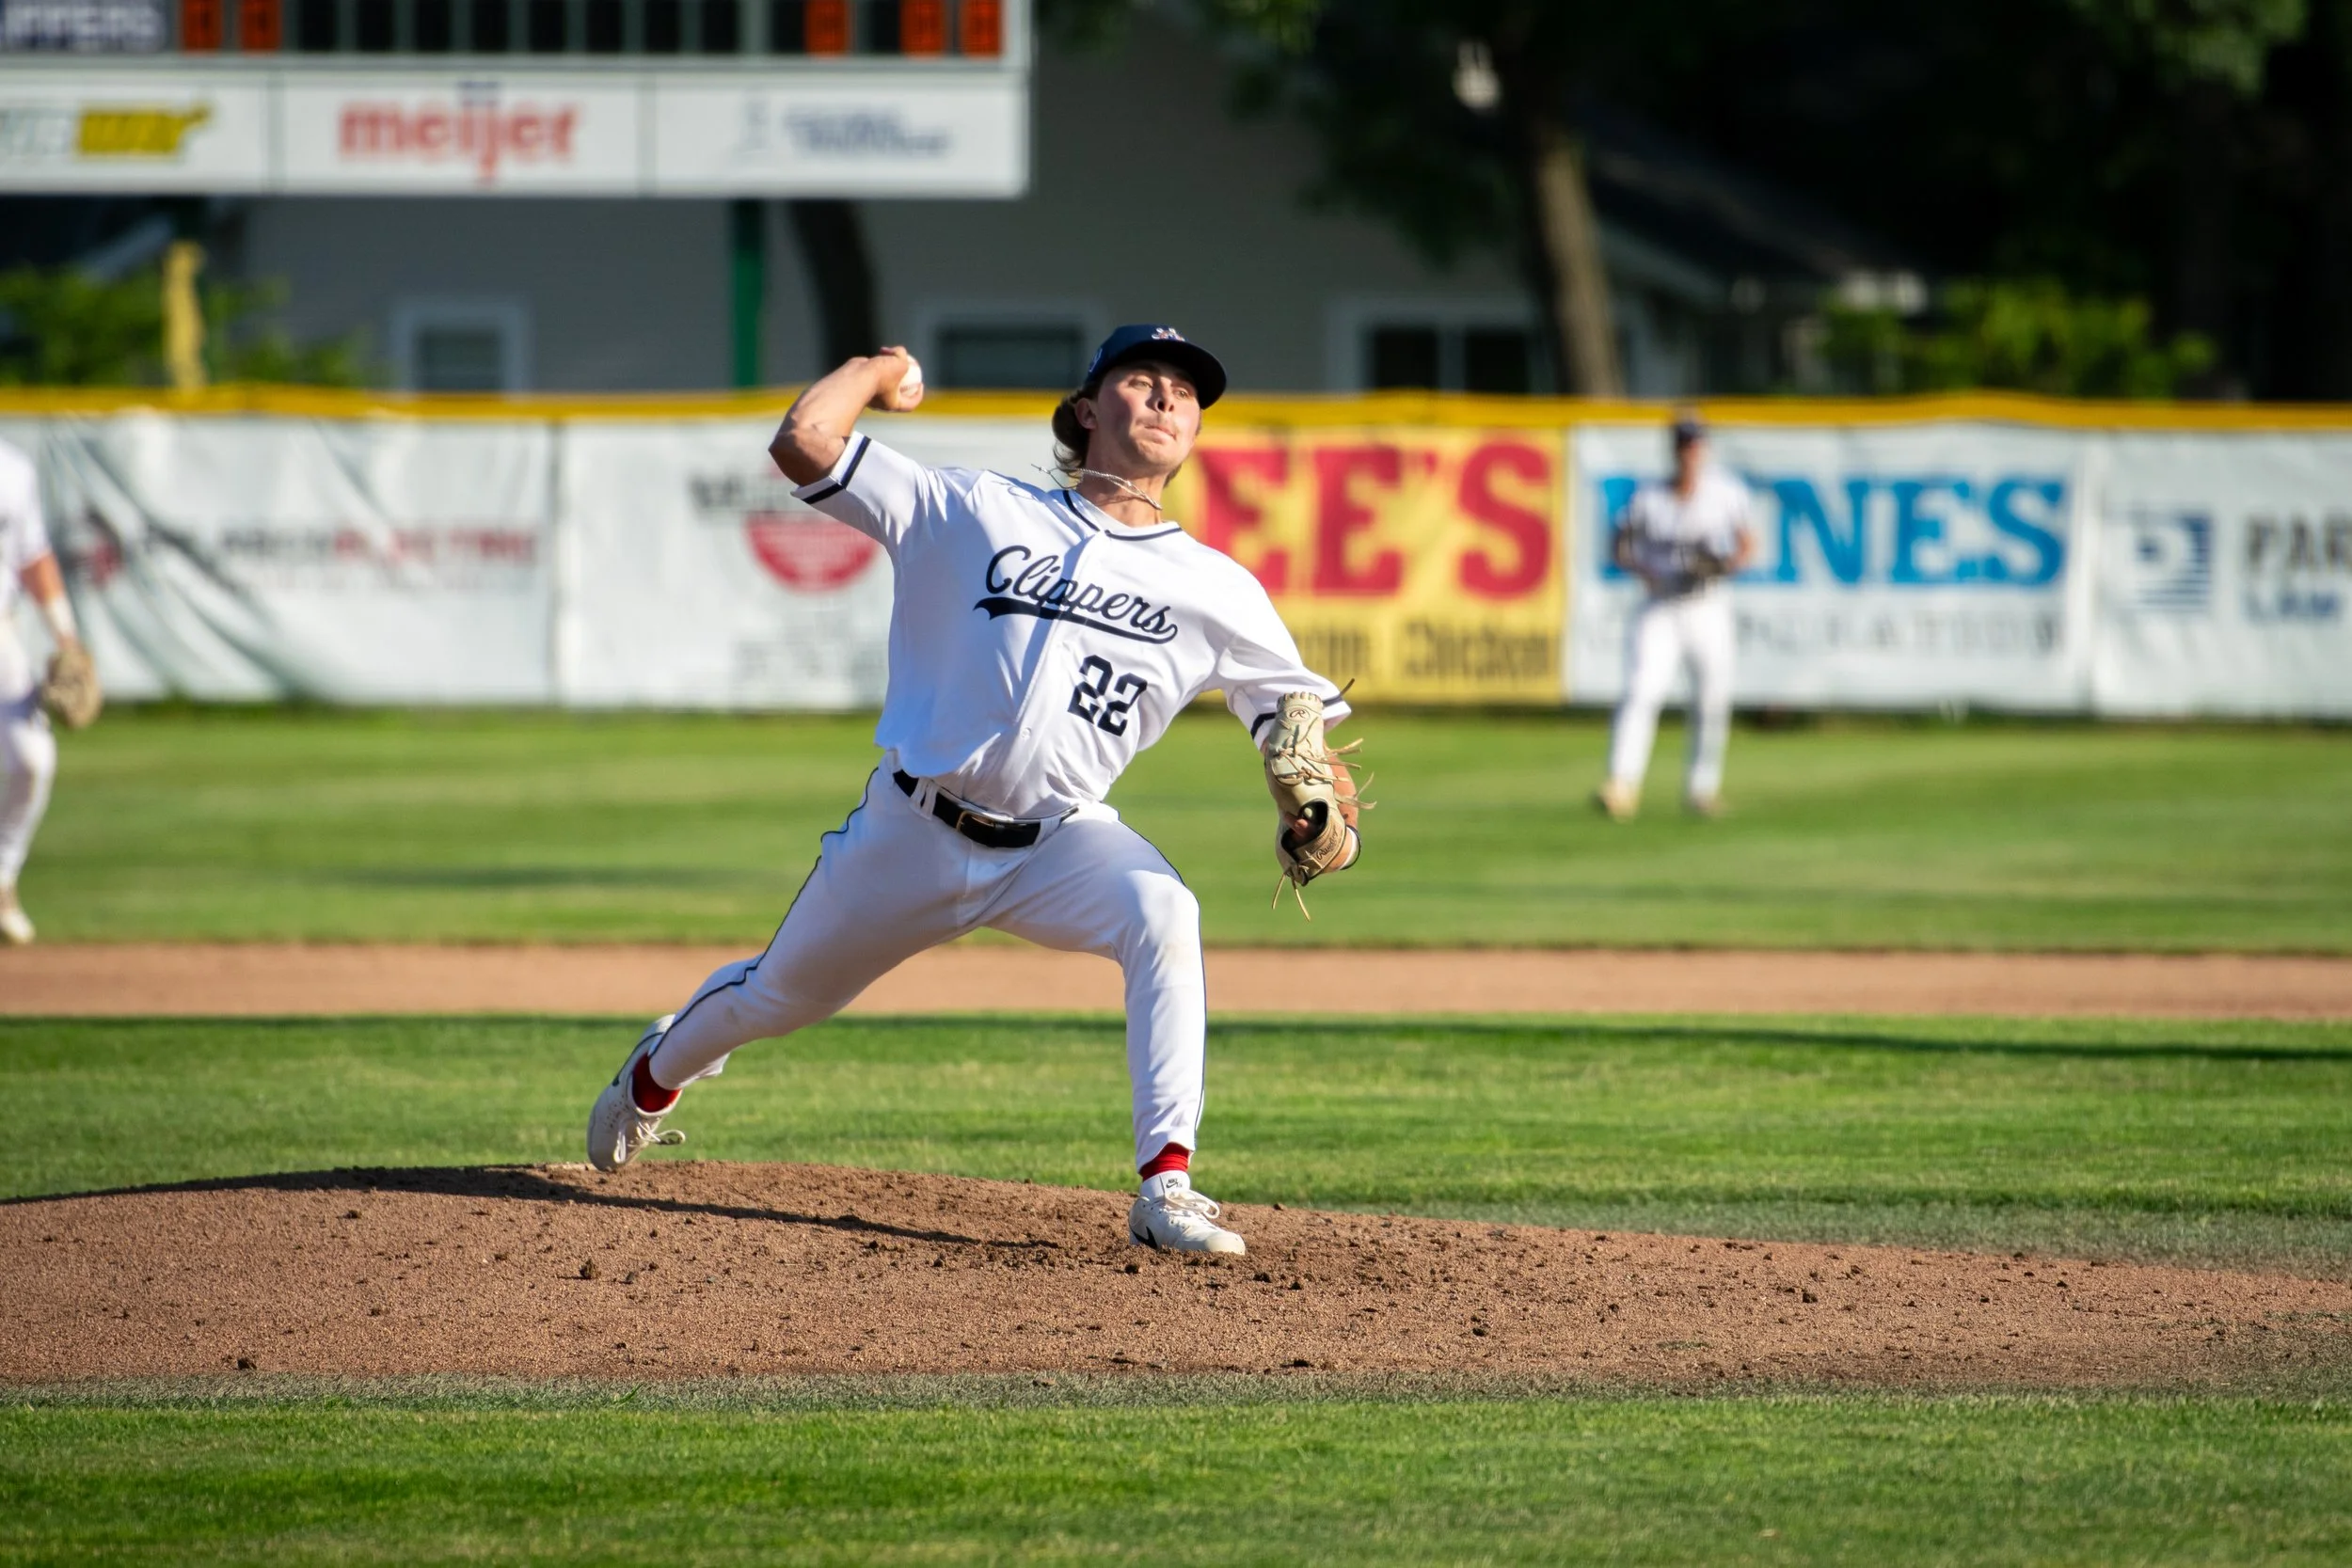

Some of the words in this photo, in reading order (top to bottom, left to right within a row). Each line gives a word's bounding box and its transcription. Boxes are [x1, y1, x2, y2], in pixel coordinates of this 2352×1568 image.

[338, 81, 577, 182] meijer
[985, 545, 1177, 640] Clippers
[1067, 654, 1148, 737] 22
